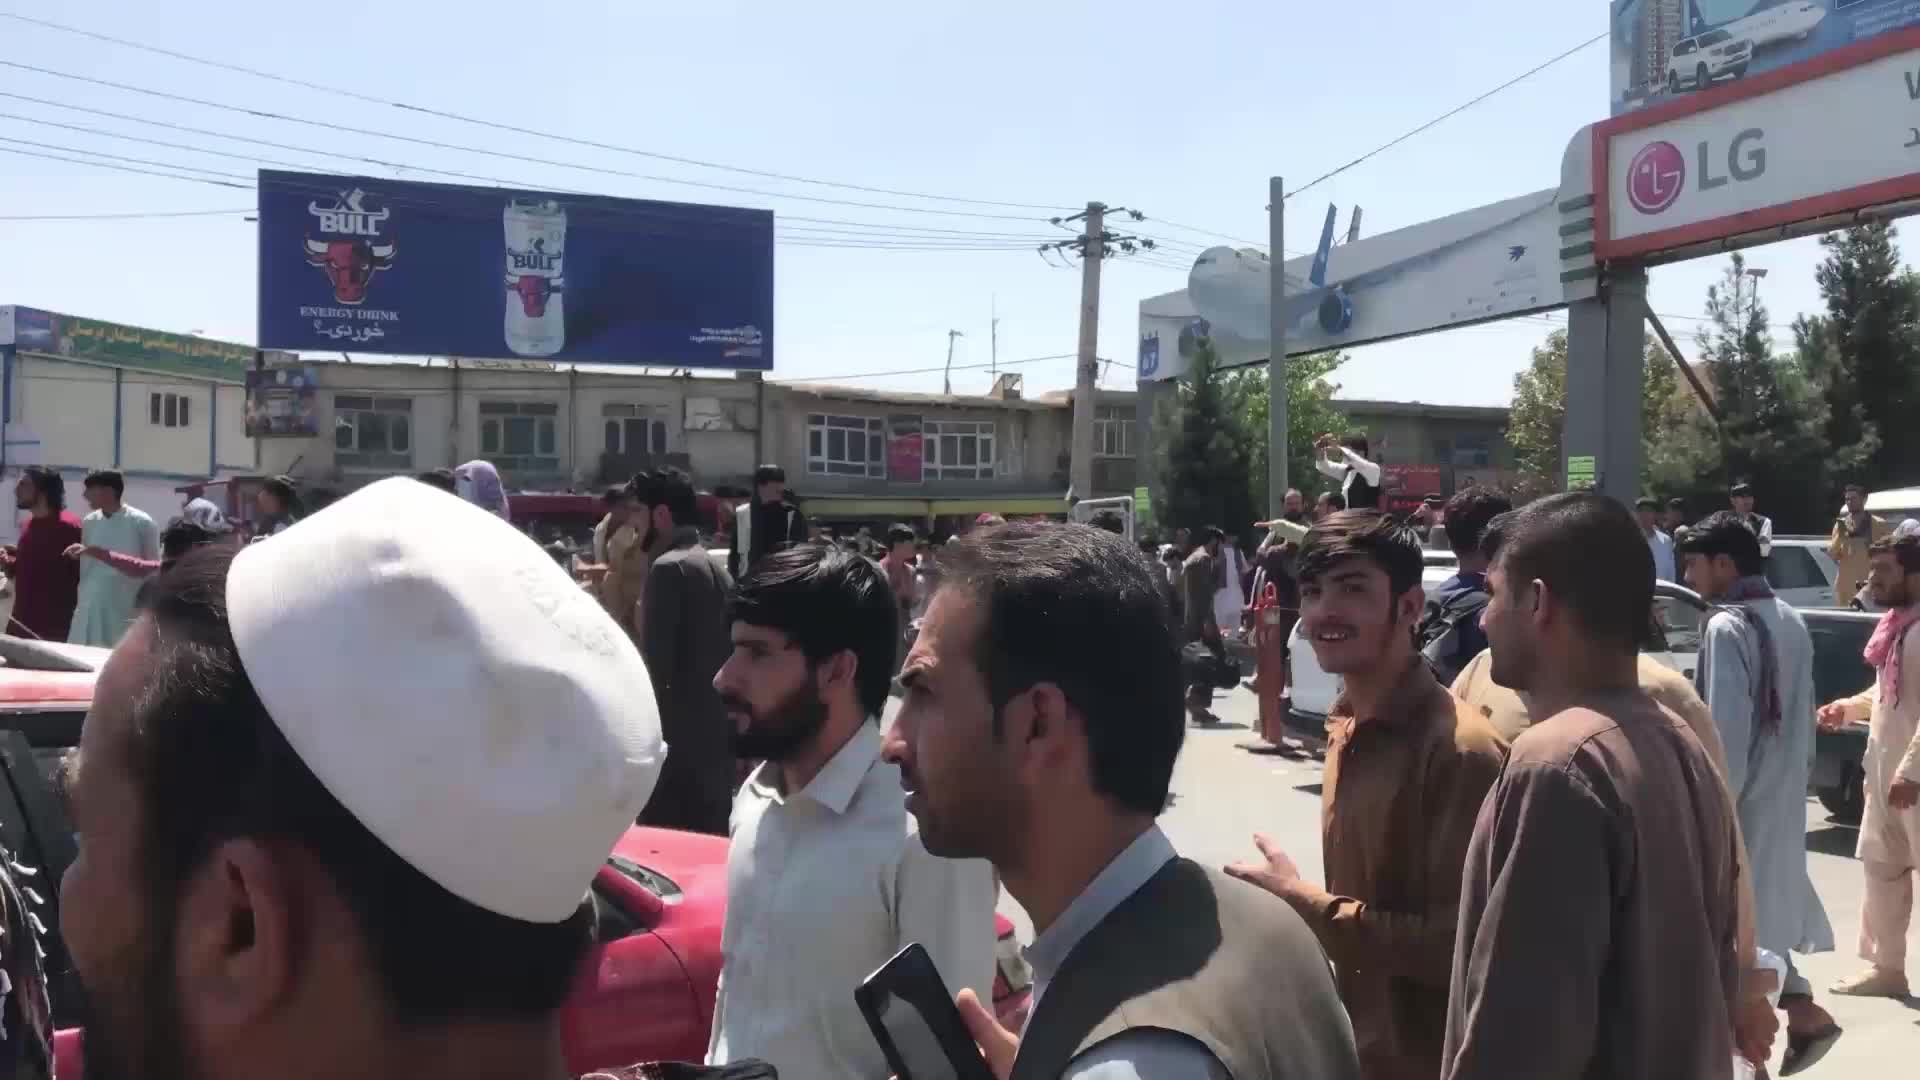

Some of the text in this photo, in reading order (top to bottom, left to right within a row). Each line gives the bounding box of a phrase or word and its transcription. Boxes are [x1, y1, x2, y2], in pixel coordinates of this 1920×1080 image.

[1697, 127, 1767, 192] LG
[308, 204, 390, 236] BULL
[300, 306, 400, 321] ENERGY DRINK
